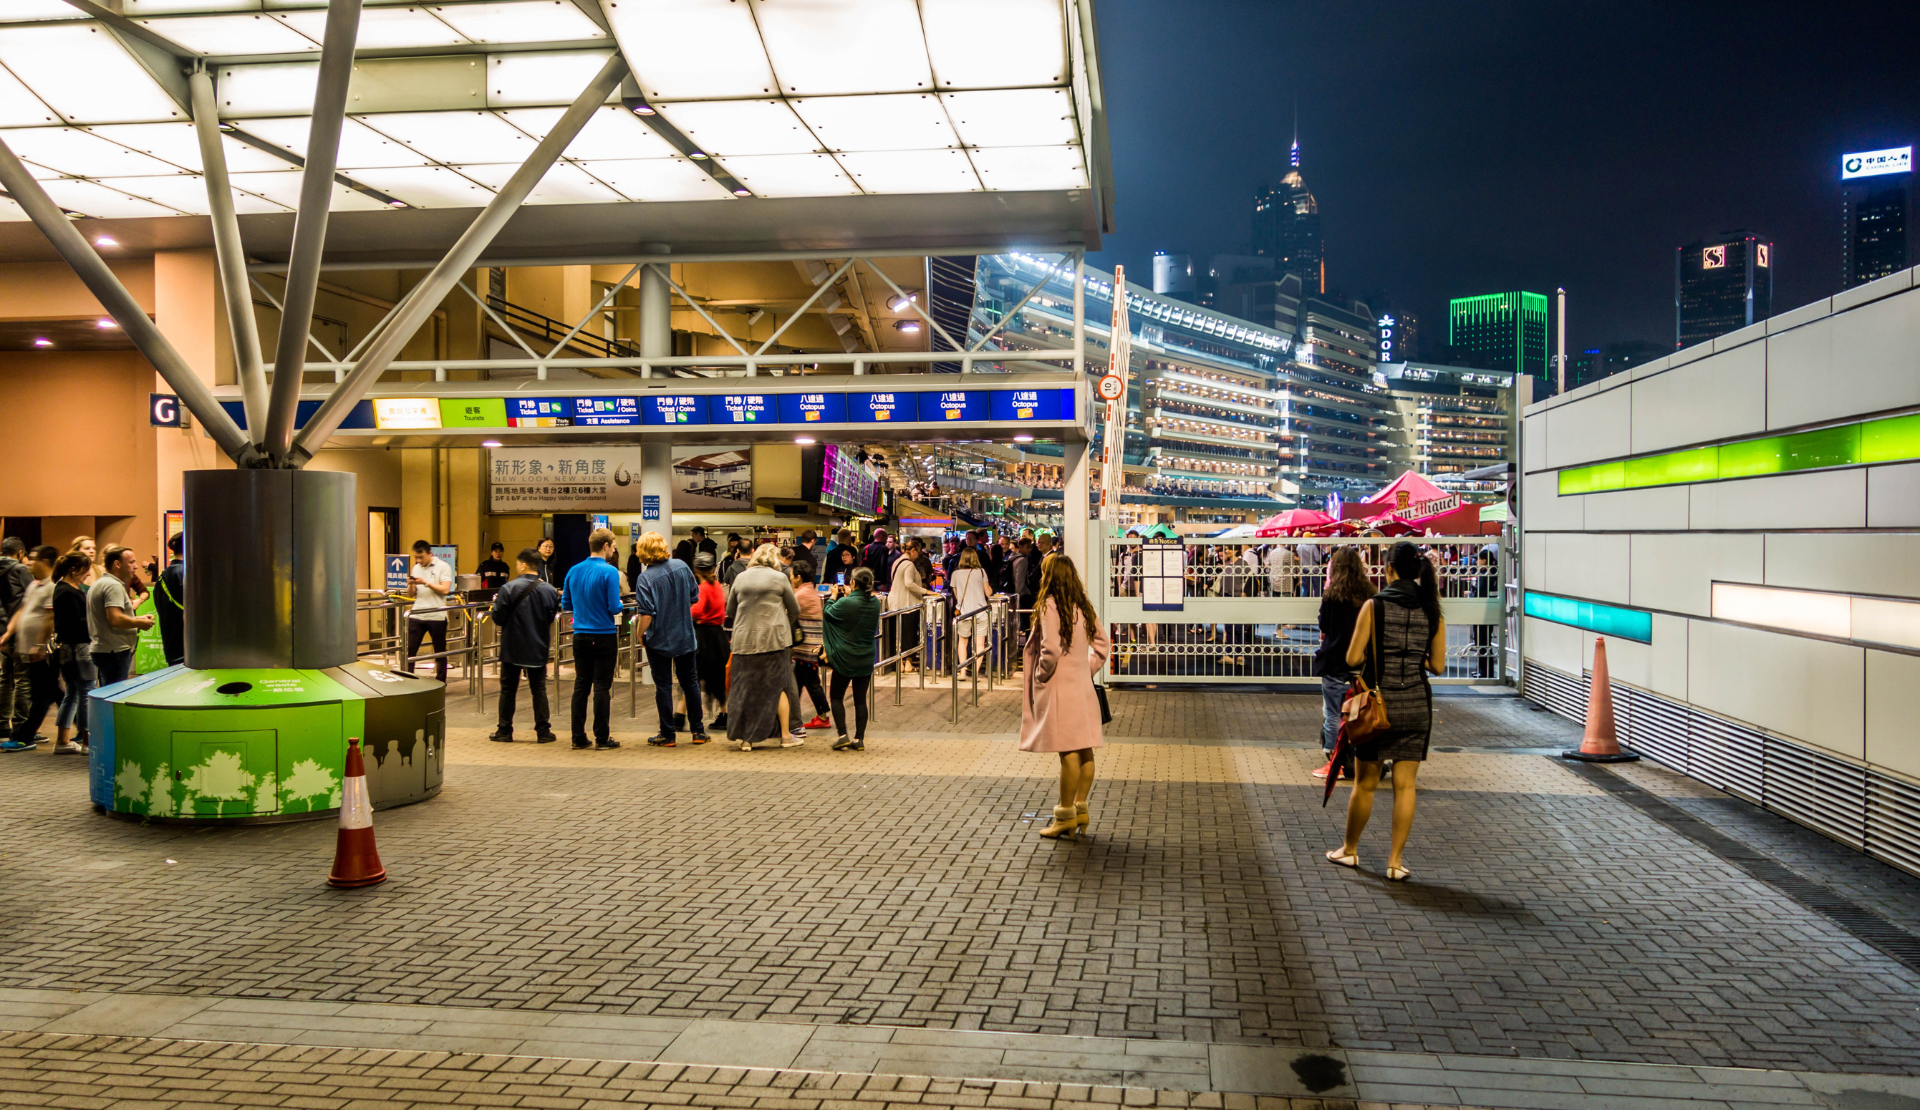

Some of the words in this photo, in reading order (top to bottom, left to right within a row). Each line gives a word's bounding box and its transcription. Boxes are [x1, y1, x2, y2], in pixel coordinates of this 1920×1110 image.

[1104, 382, 1111, 392] 10
[800, 394, 824, 403] 八達通
[870, 394, 894, 402] 八達通
[941, 392, 965, 401] 八達通
[1013, 391, 1037, 400] 八達通
[155, 398, 175, 423] G
[495, 459, 542, 475] 新形象
[558, 459, 606, 475] 新角度
[1413, 494, 1457, 517] Miguel
[644, 509, 659, 517] $10
